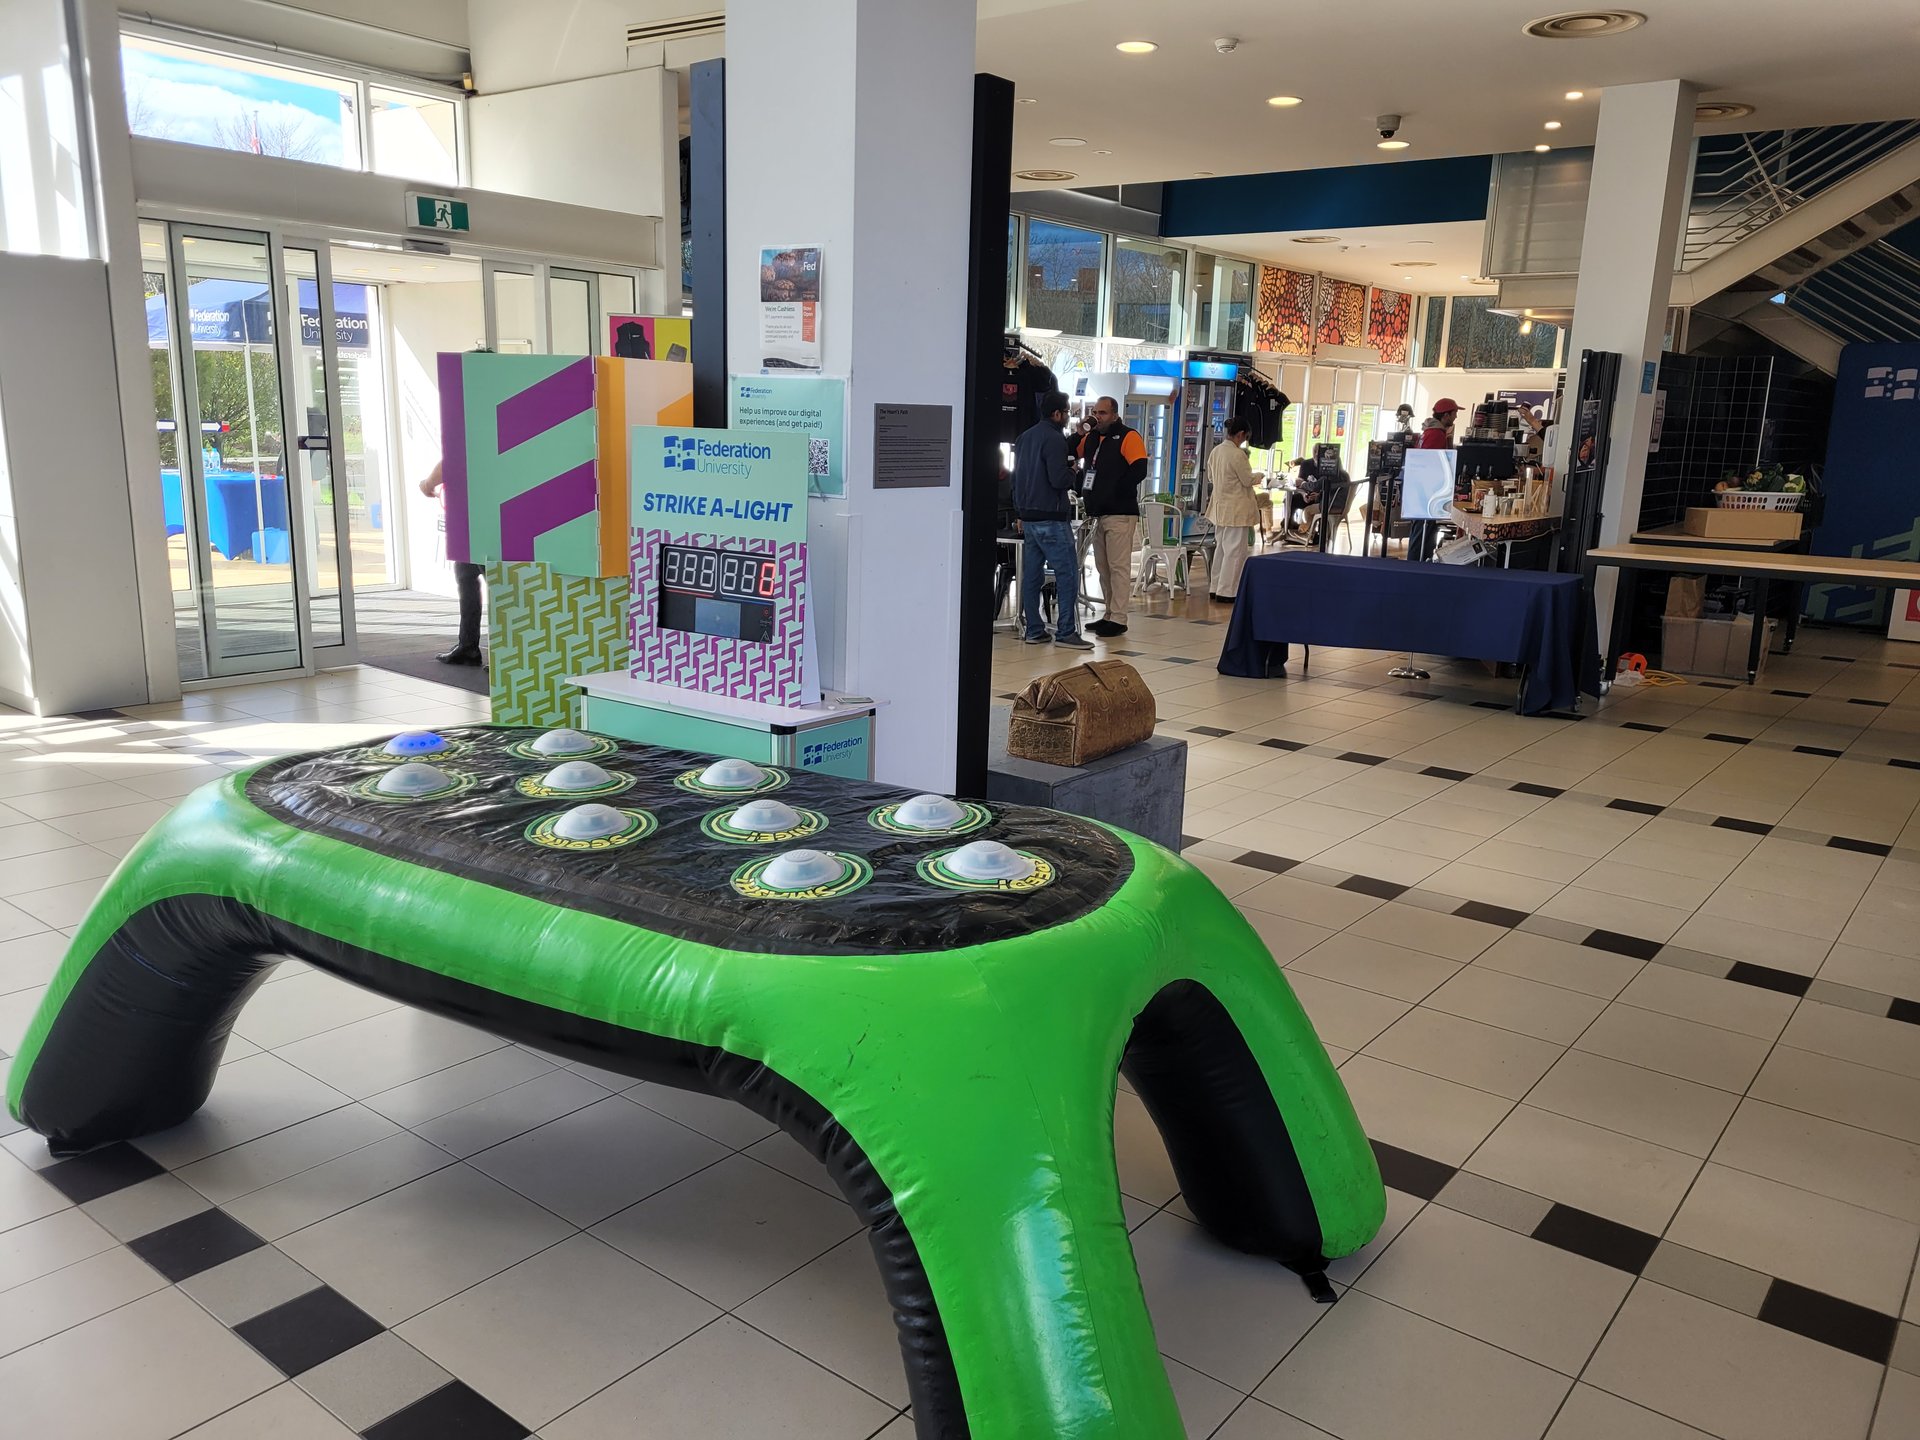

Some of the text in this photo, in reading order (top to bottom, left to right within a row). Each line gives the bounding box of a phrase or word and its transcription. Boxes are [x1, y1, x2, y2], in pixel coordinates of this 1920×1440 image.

[803, 261, 817, 271] Fed
[194, 308, 229, 322] Federation
[300, 314, 368, 330] Feation
[303, 327, 354, 343] Unisity
[750, 387, 772, 395] Federation
[740, 406, 753, 416] Help
[762, 408, 787, 417] improve
[800, 410, 821, 418] digital
[740, 418, 775, 427] experiences
[776, 419, 790, 430] (and
[791, 421, 802, 429] get
[697, 439, 771, 460] Federation
[697, 459, 752, 480] University
[643, 492, 793, 523] STRIKE A-LIGHT
[823, 736, 863, 753] Federation
[823, 749, 853, 763] University
[531, 832, 629, 850] SCORE!
[747, 824, 817, 843] NICE!
